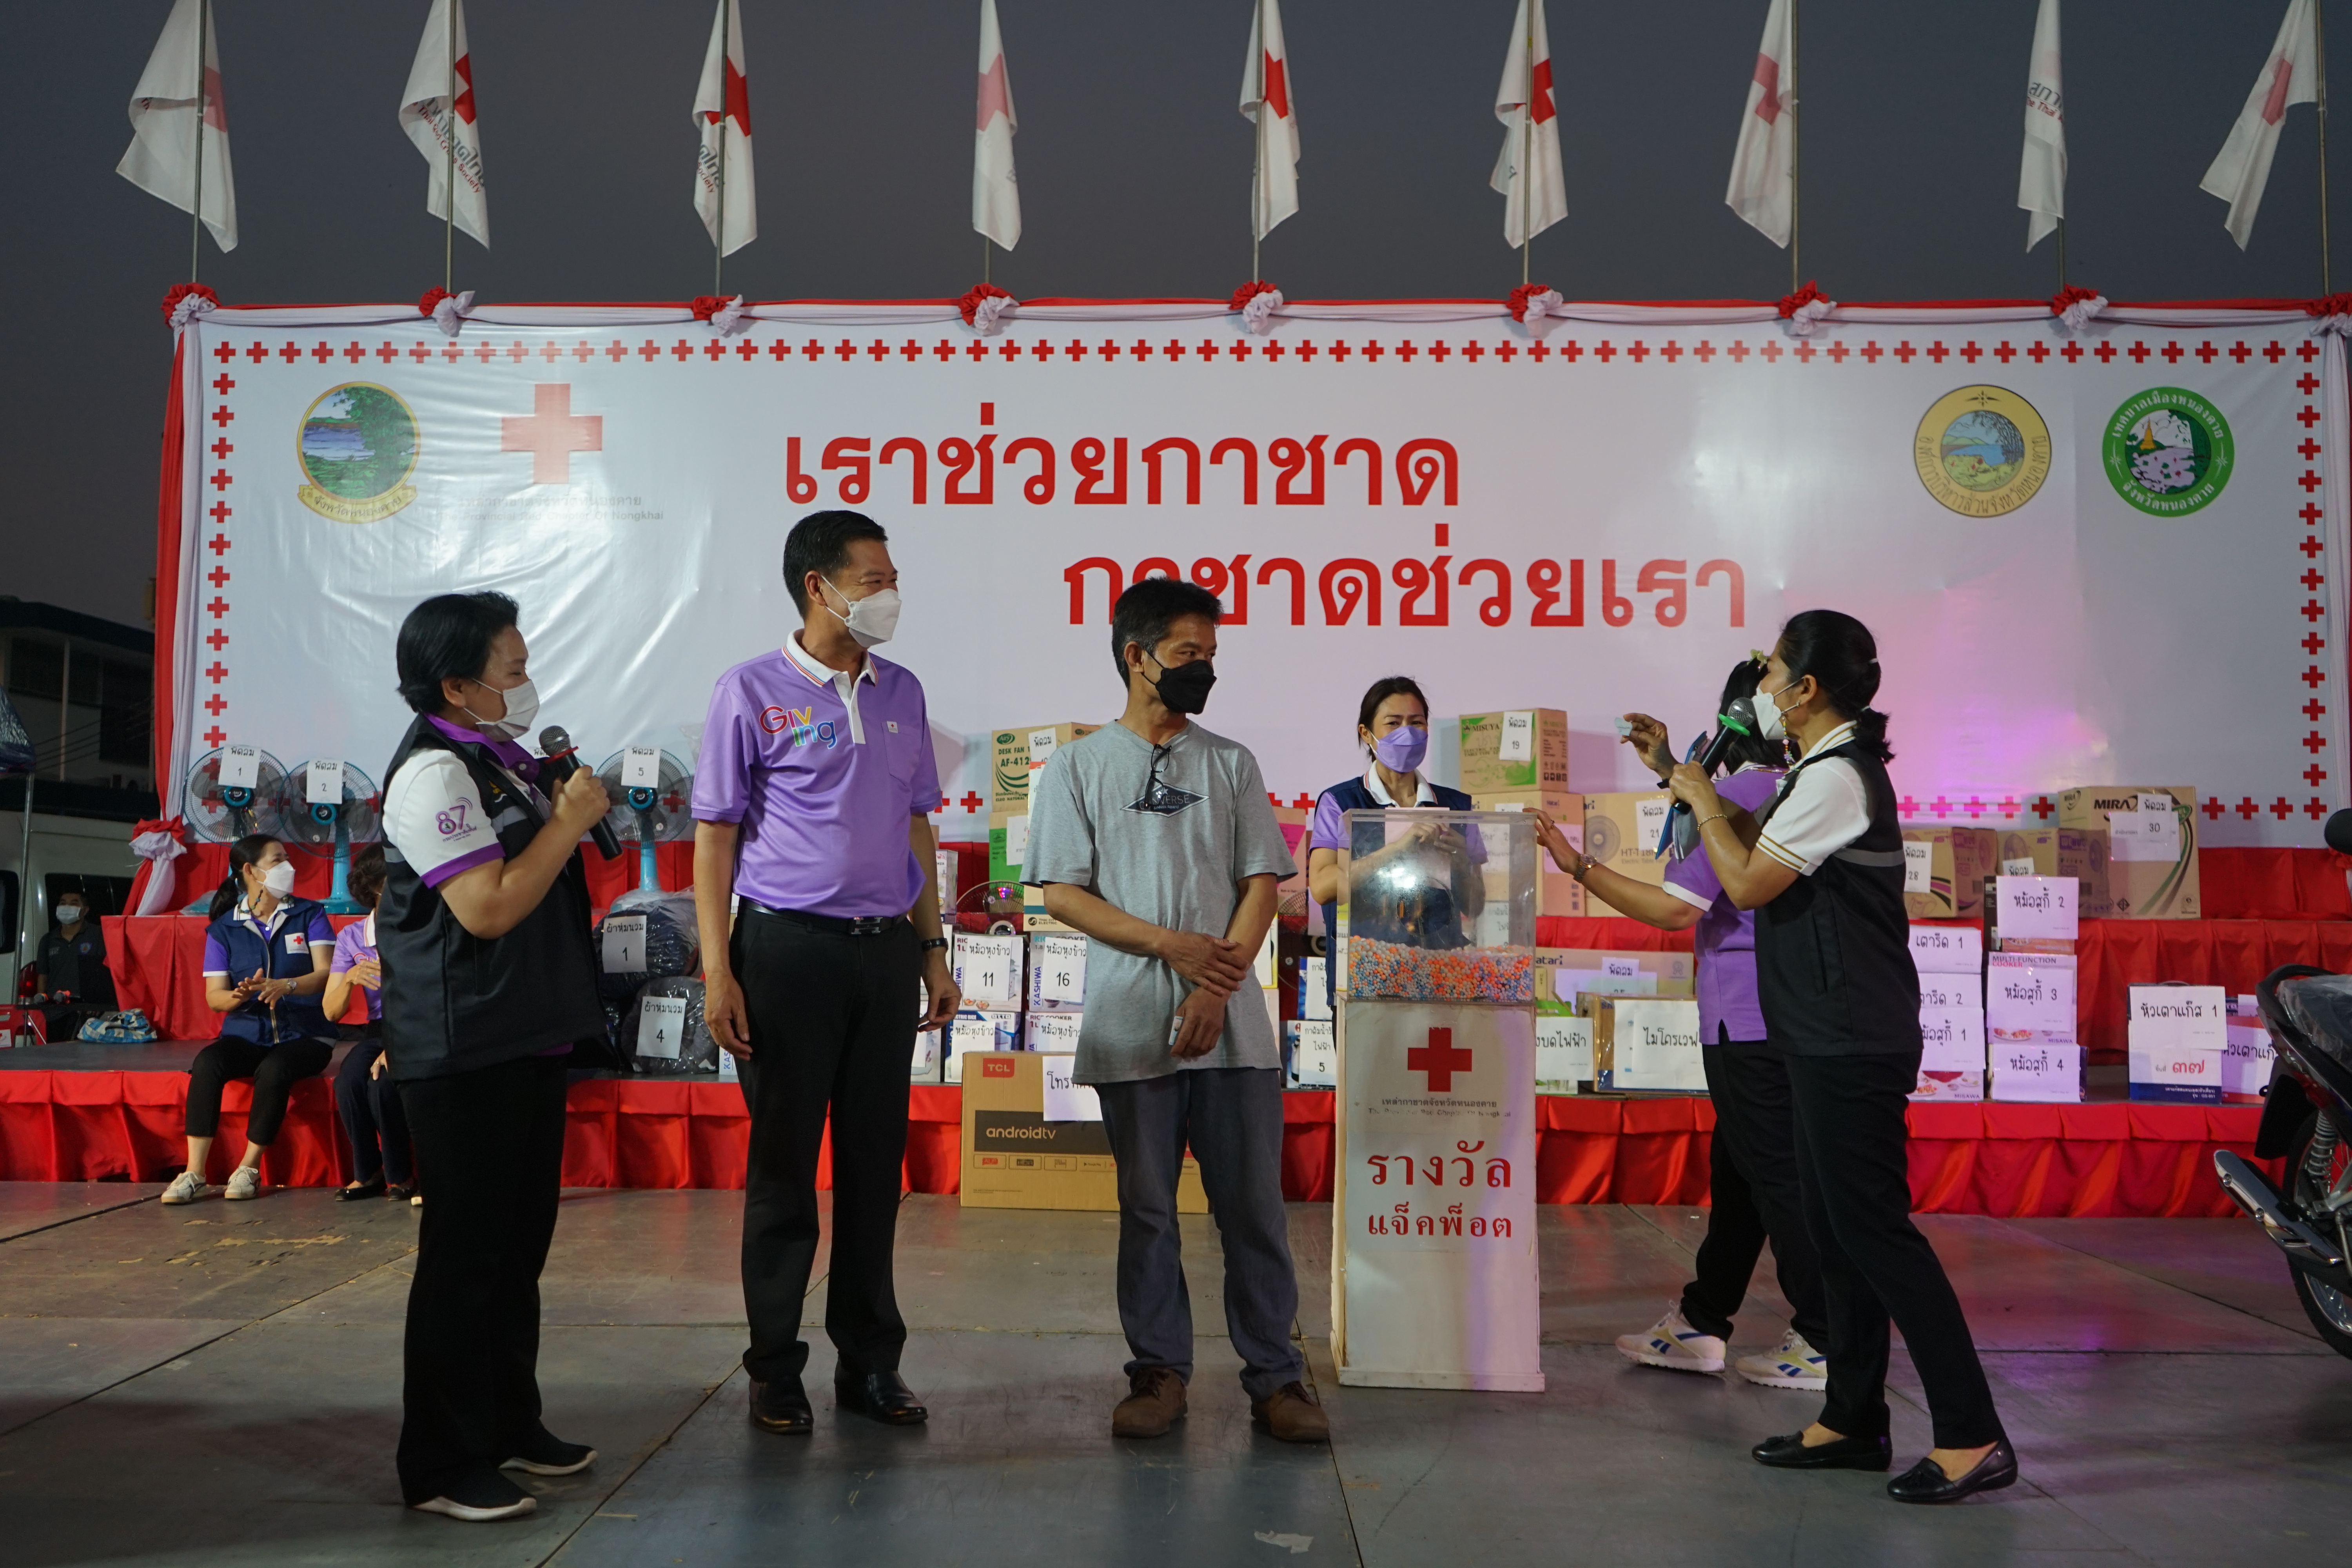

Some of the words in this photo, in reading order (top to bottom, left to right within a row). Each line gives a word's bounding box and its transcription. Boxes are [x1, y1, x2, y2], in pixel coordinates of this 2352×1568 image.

[786, 402, 1459, 505] เราช่วยกาชาด
[612, 510, 663, 523] Nongkhai
[1472, 723, 1500, 732] MISUYA
[1508, 717, 1527, 728] พัดลม
[1512, 740, 1520, 750] 19
[238, 767, 242, 777] 1
[315, 760, 338, 771] พัดลม
[638, 767, 644, 777] 5
[321, 783, 327, 792] 2
[1642, 806, 1664, 817] พัดลม
[2144, 799, 2167, 811] พัดลม
[1650, 828, 1659, 838] 21
[2149, 823, 2161, 833] 30
[1908, 871, 1919, 881] 28
[2014, 886, 2050, 913] หม้อสุกี้
[2058, 896, 2065, 908] 2
[606, 923, 644, 934] ผ้าห่มนวม
[1916, 932, 1949, 949] เตารีด
[1958, 936, 1963, 949] 1
[622, 946, 628, 961] 1
[969, 942, 1011, 959] หม้อหุงข้าว
[1046, 942, 1087, 959] หม้อหุงข้าว
[1536, 955, 1563, 965] atari
[1608, 964, 1633, 976] พัดลม
[982, 972, 994, 987] 11
[1034, 966, 1042, 1006] KASHIWA
[1056, 972, 1070, 987] 16
[2005, 978, 2042, 1005] หม้อสุกี้
[2051, 988, 2057, 1001] 3
[1956, 993, 1963, 1005] 2
[644, 1000, 683, 1014] ผ้าห่มนวม
[2141, 1000, 2202, 1019] หัวเตาแก๊ส
[2212, 1004, 2218, 1018] 1
[656, 1029, 665, 1044] 4
[955, 1024, 994, 1039] หม้อหุงข้าว
[1643, 1027, 1698, 1047] ไมโครเวฟ
[1961, 1028, 1966, 1042] 1
[987, 1063, 1010, 1072] TCL
[1319, 1062, 1325, 1072] 5
[2010, 1049, 2048, 1077] หม้อสุกี้
[2057, 1059, 2064, 1071] 4
[1367, 1140, 1511, 1188] รางวัล
[1368, 1201, 1512, 1238] แจ็คพ็อต
